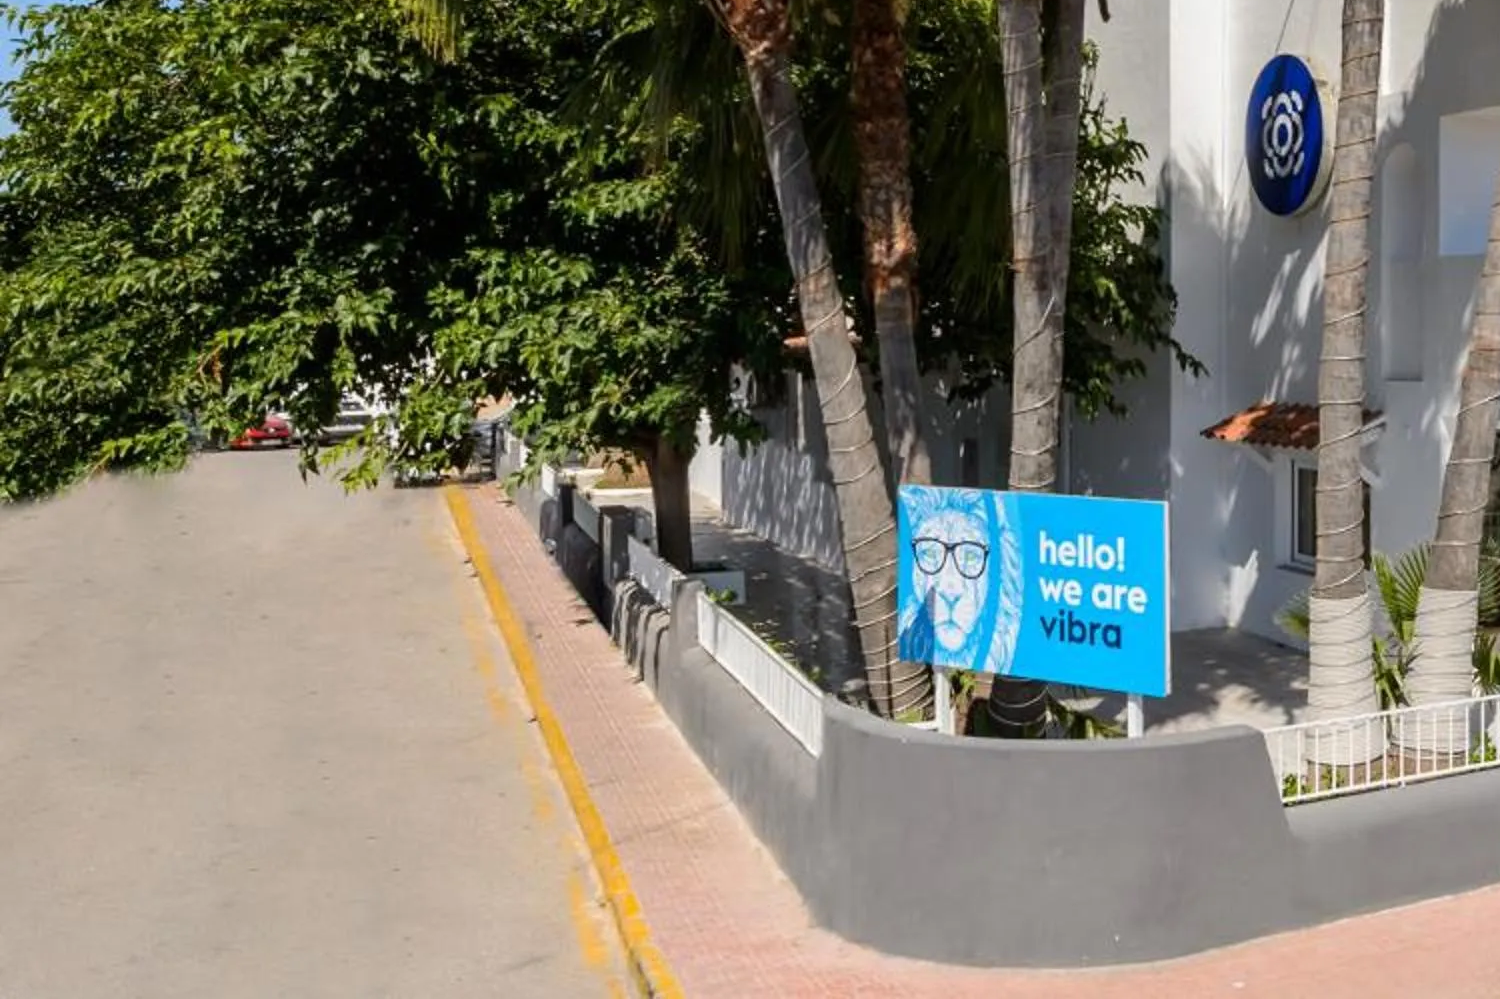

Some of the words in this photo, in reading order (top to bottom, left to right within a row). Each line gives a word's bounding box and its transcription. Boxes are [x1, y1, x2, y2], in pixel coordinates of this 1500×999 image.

[1039, 531, 1125, 571] hello!
[1039, 576, 1082, 606] we
[1091, 584, 1148, 613] are
[1039, 610, 1122, 649] vibra
